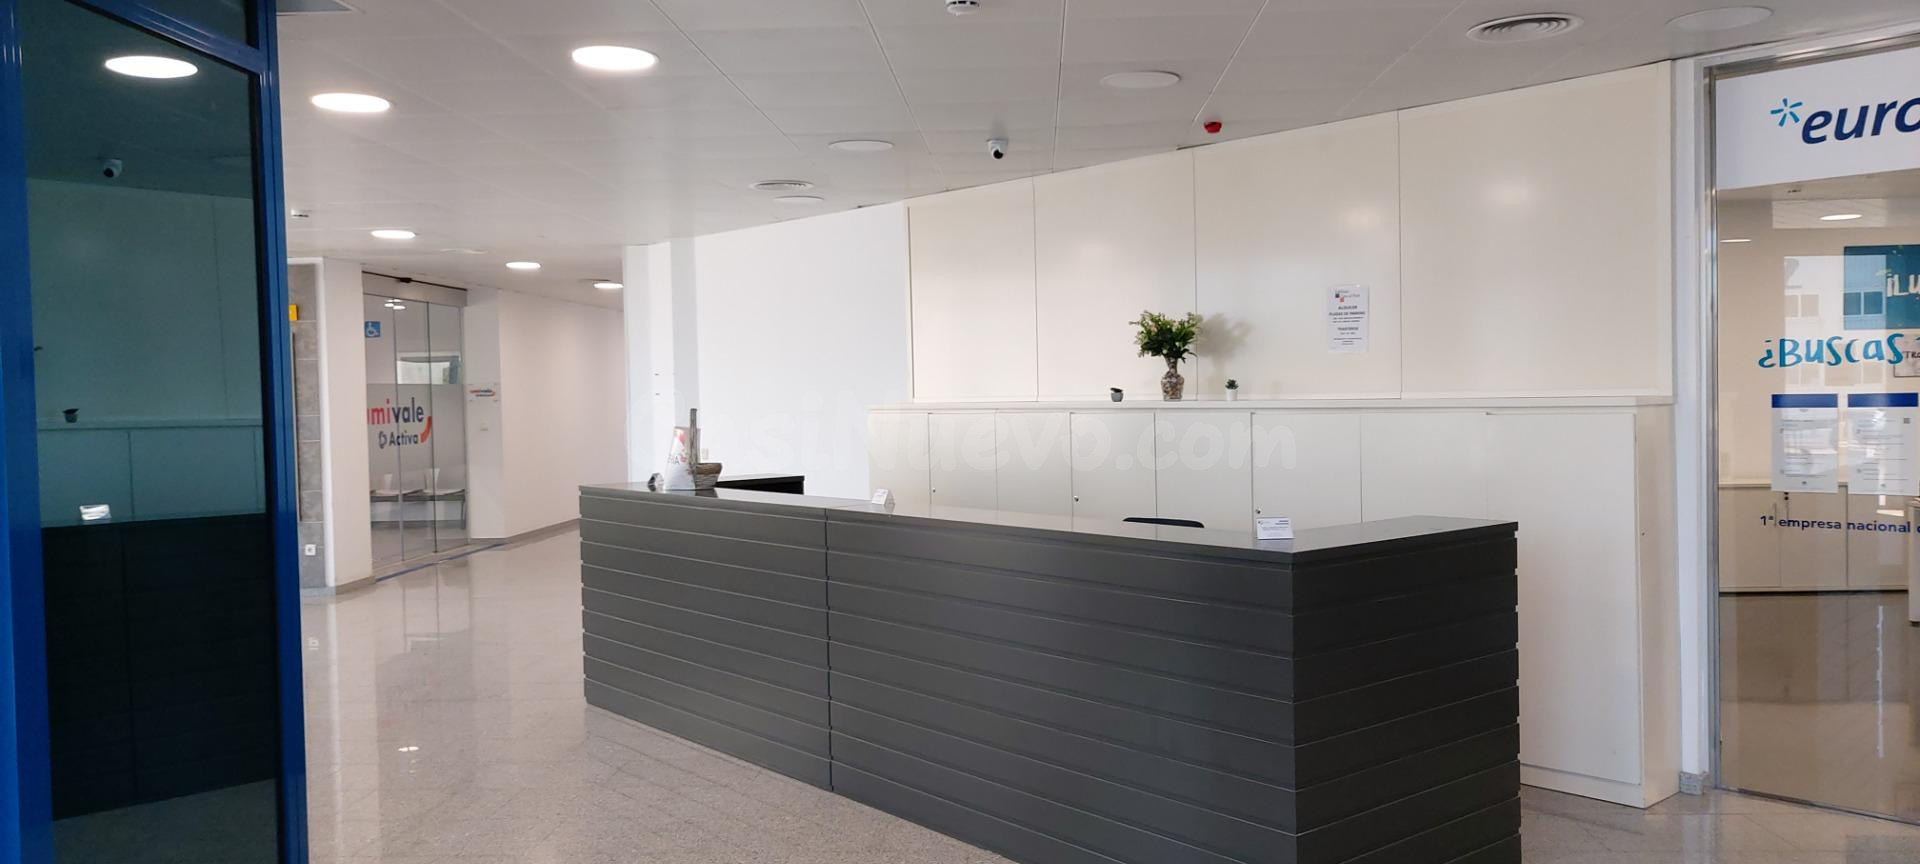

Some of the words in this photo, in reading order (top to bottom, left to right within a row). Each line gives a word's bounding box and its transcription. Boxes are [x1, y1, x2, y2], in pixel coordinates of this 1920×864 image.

[1802, 97, 1920, 145] euro
[1779, 518, 1842, 531] empresa
[1847, 520, 1911, 533] nacional
